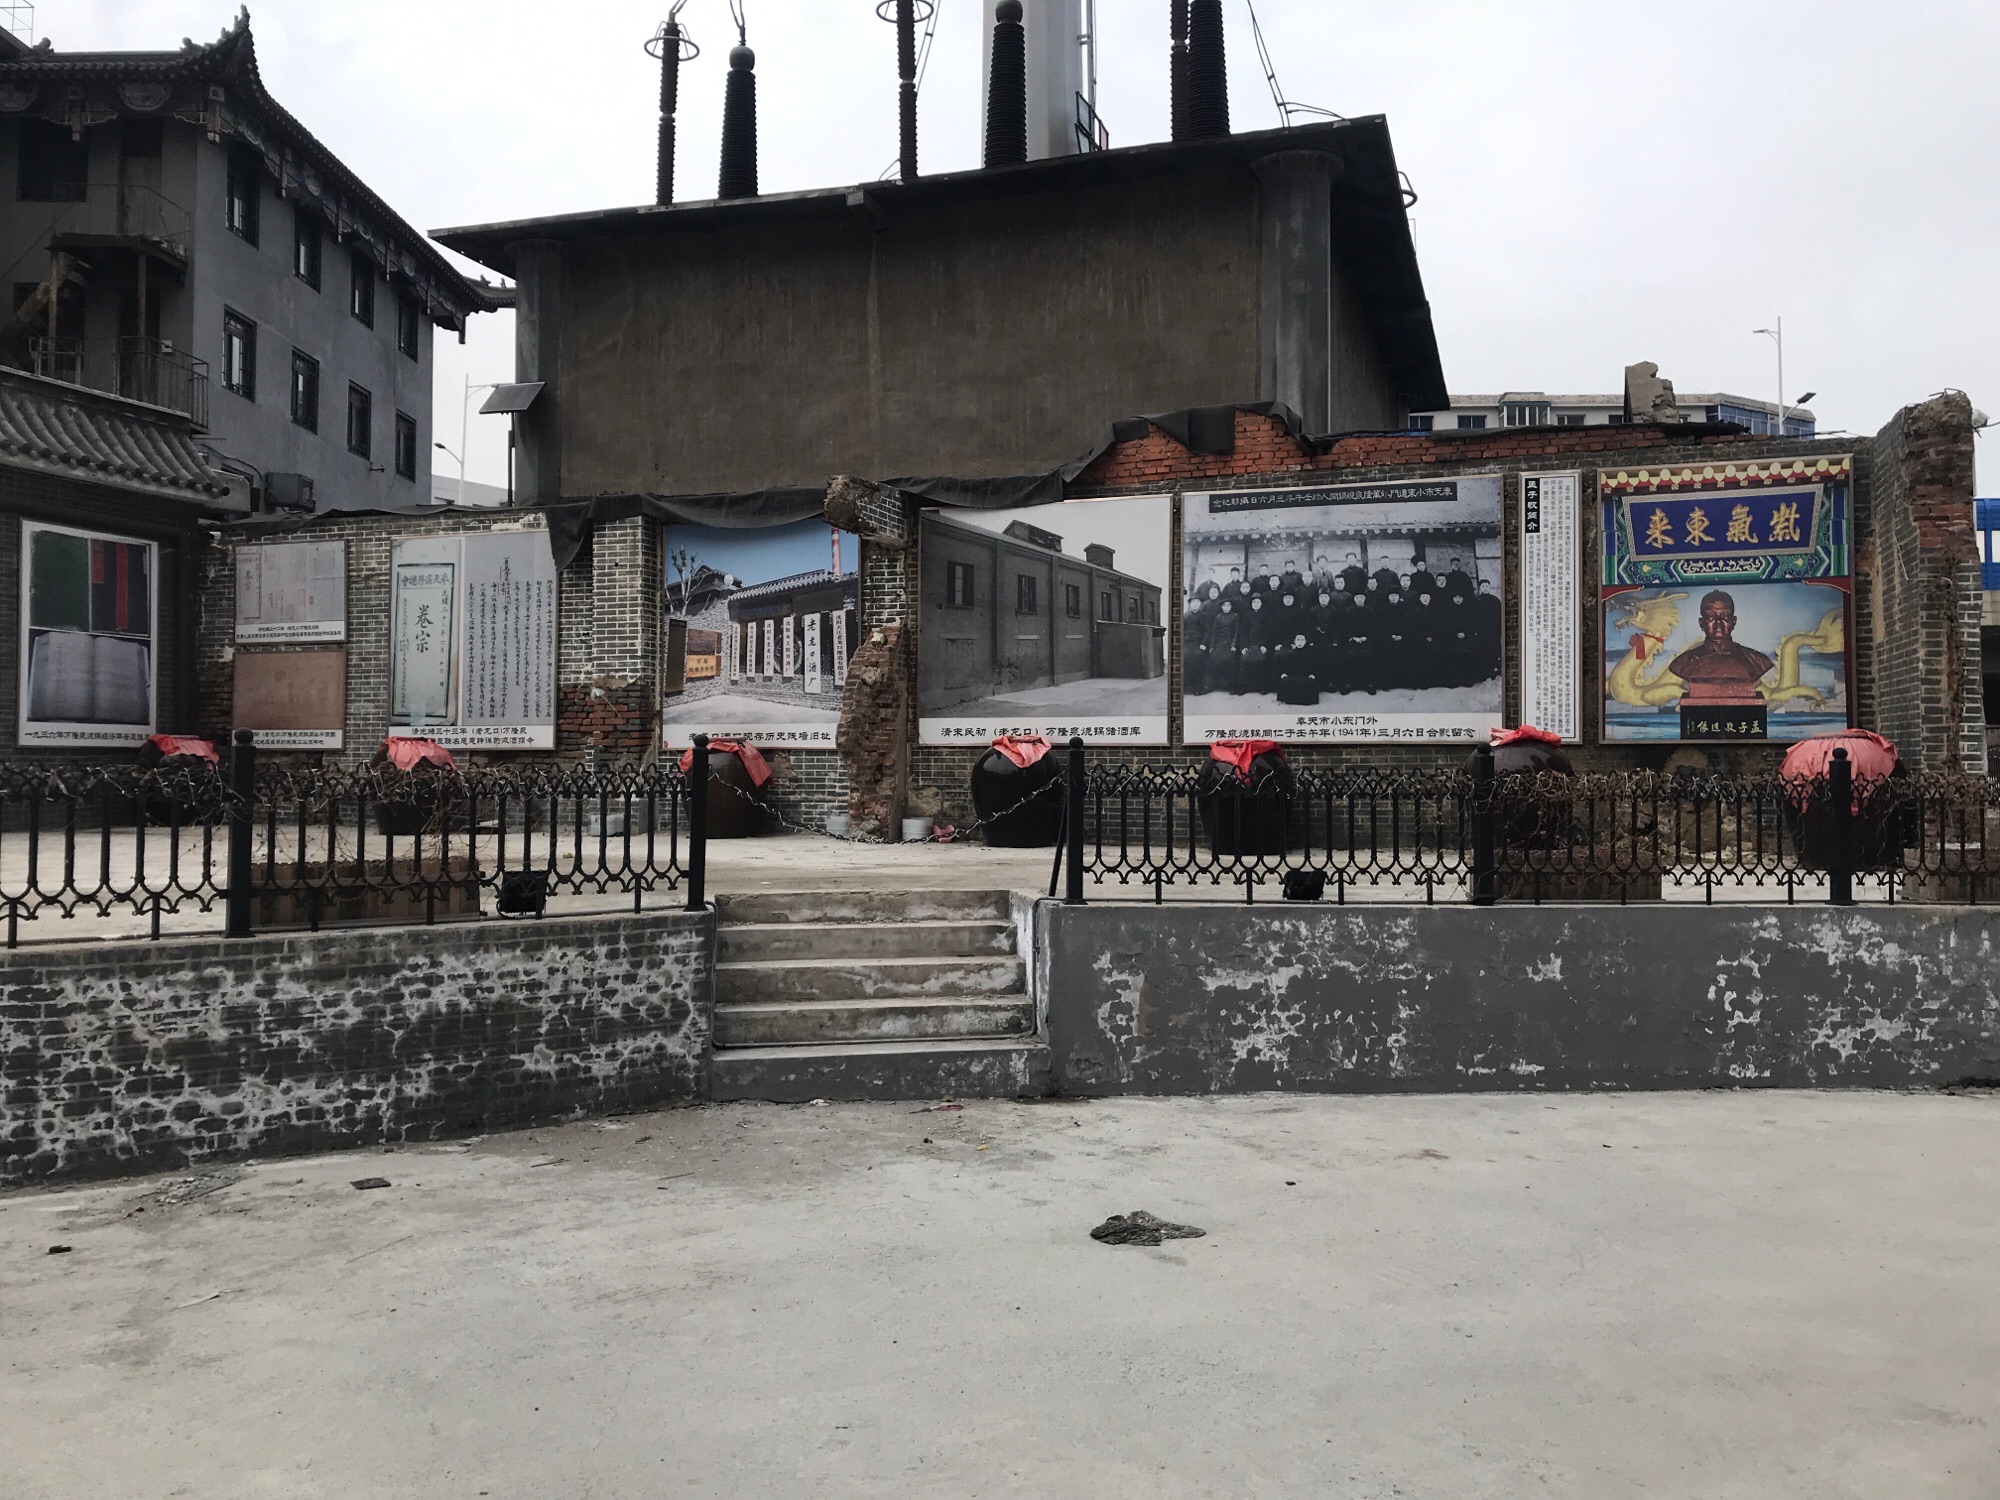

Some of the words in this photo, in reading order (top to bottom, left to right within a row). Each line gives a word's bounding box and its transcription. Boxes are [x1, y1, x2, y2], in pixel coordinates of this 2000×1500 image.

[1526, 480, 1538, 531] 孟子敬简介
[414, 604, 434, 654] 卷宗
[1296, 716, 1378, 726] 奉天市小东门外
